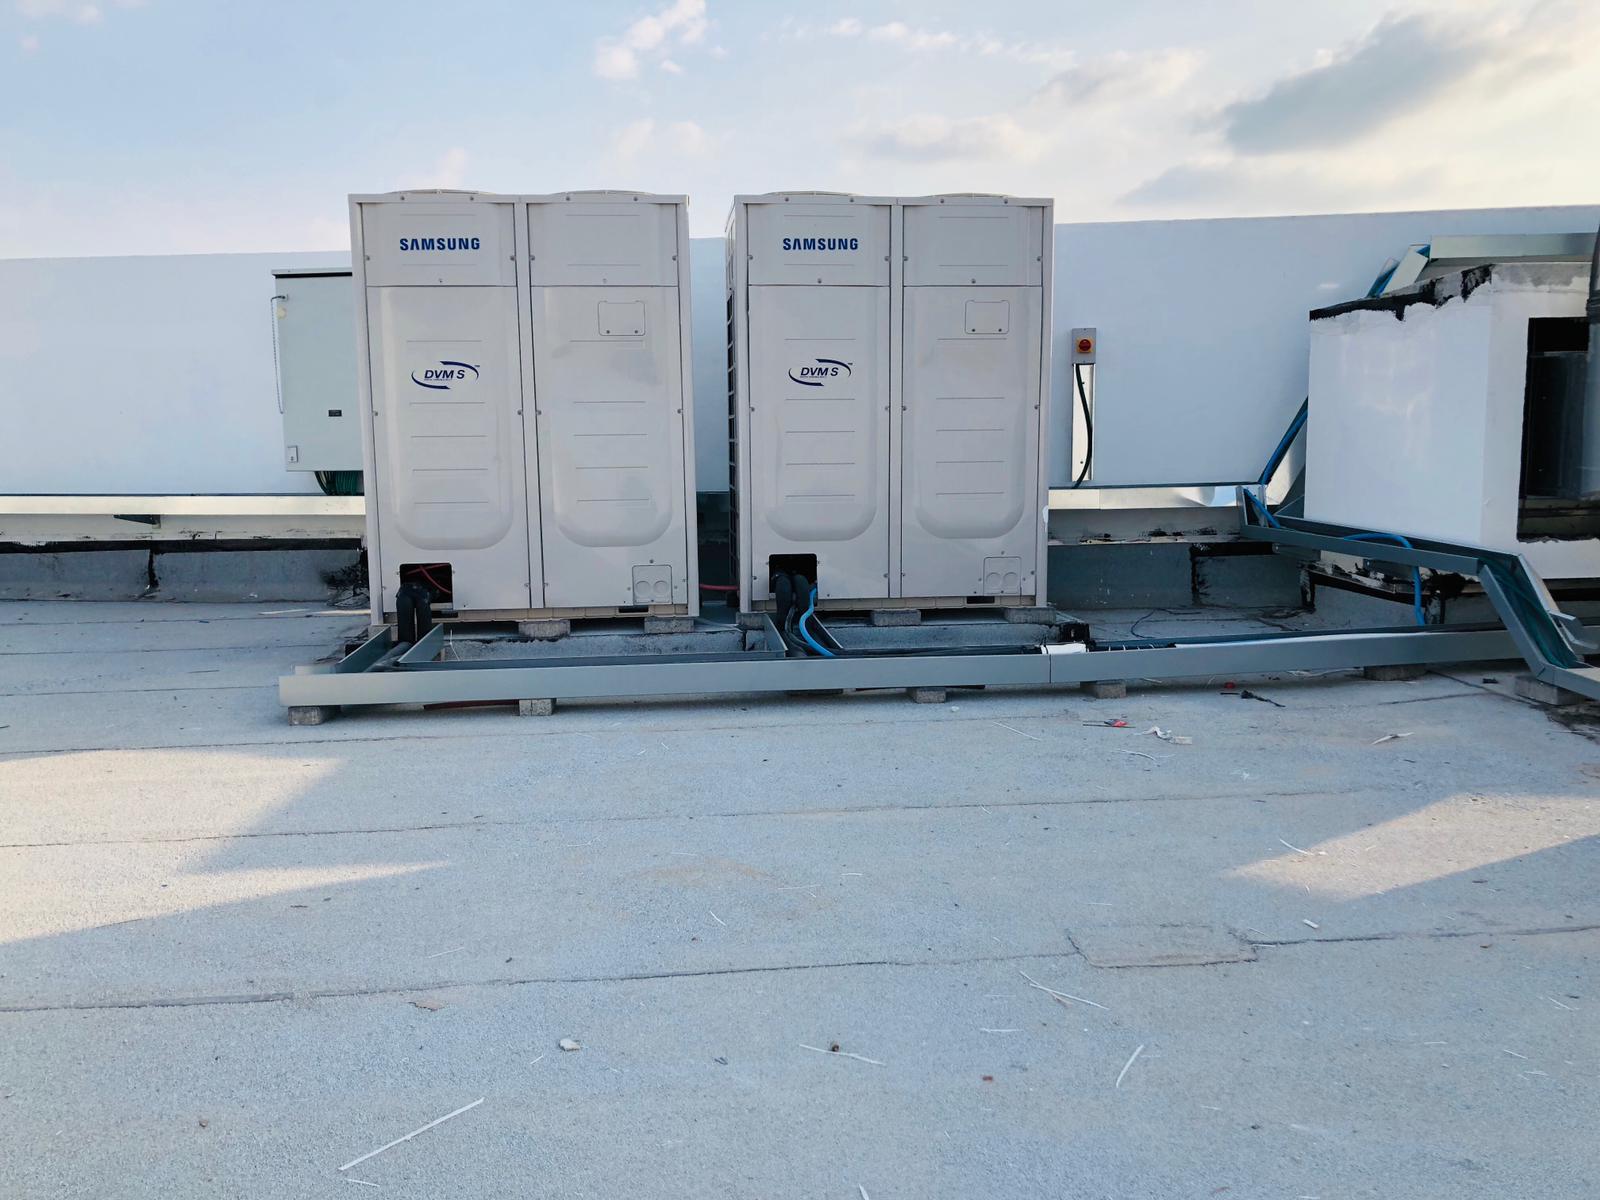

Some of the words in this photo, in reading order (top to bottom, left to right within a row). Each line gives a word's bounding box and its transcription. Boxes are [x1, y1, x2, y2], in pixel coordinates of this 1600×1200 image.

[399, 238, 480, 251] SAMSUNG
[782, 238, 858, 251] SAMSUNG
[424, 369, 454, 379] DVM
[456, 369, 466, 380] S
[800, 367, 829, 376] DVM
[830, 367, 839, 377] S
